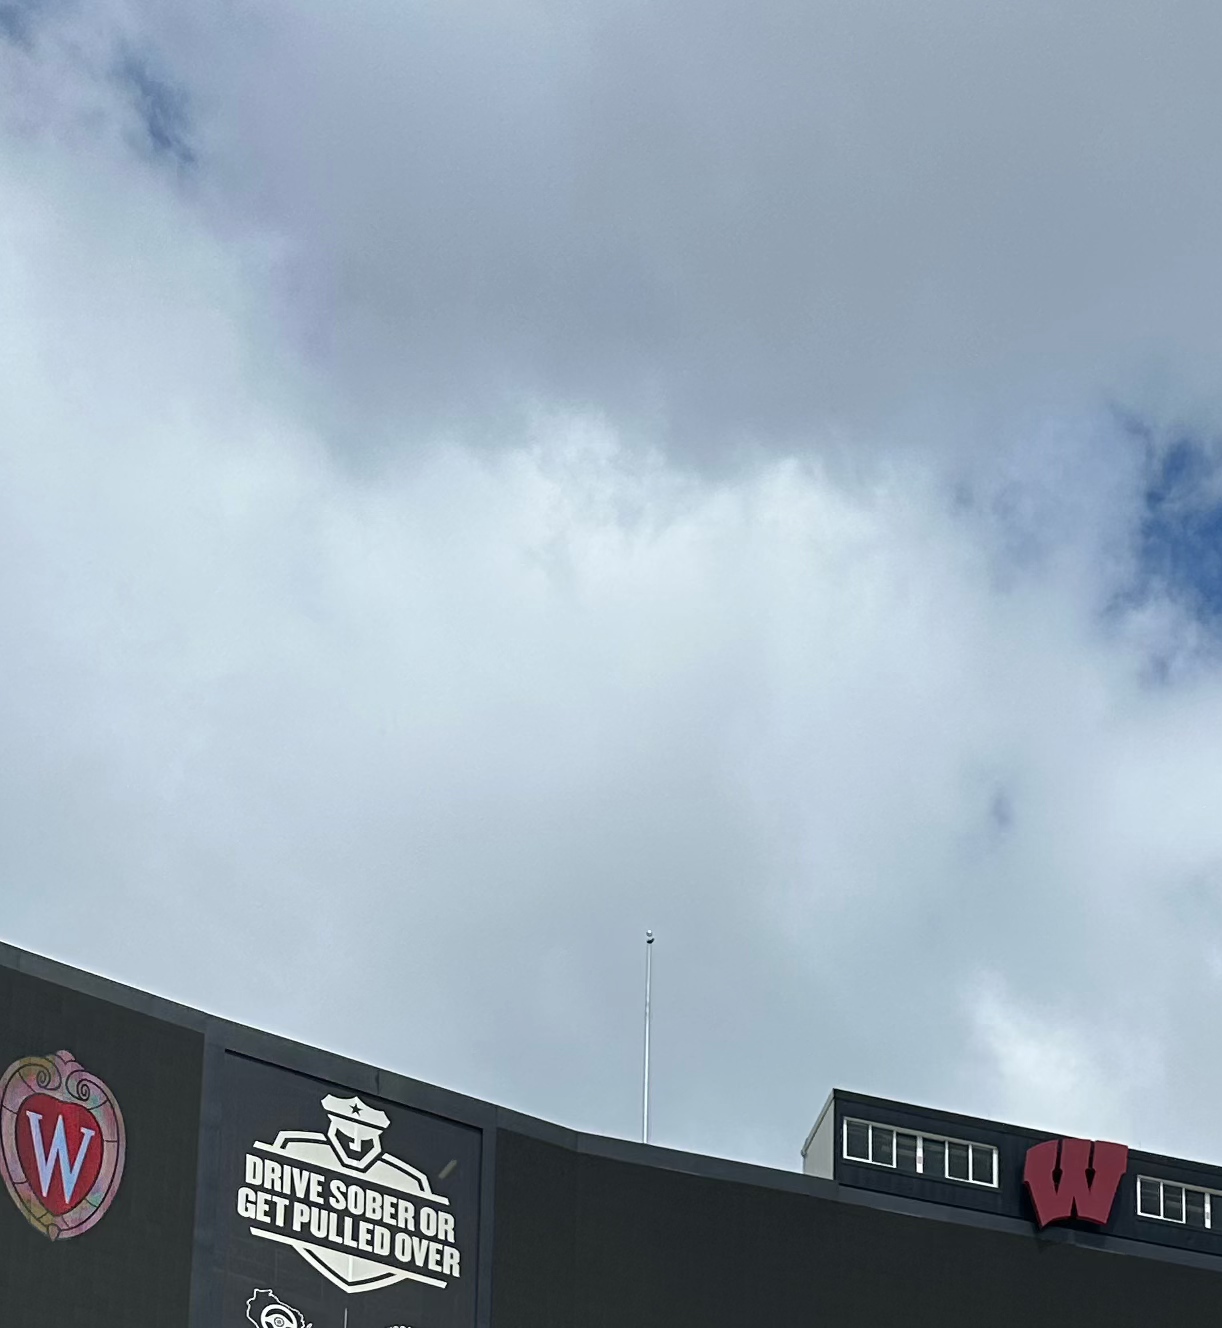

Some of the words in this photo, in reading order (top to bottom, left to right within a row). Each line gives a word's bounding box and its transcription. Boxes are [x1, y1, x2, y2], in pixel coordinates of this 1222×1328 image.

[26, 1110, 95, 1204] W
[245, 1153, 325, 1205] DRIVE
[328, 1179, 415, 1232] SOBER
[419, 1206, 456, 1244] OR
[1023, 1138, 1129, 1229] W
[237, 1186, 290, 1228] GET
[292, 1201, 391, 1256] PULLED
[394, 1232, 461, 1278] OVER
